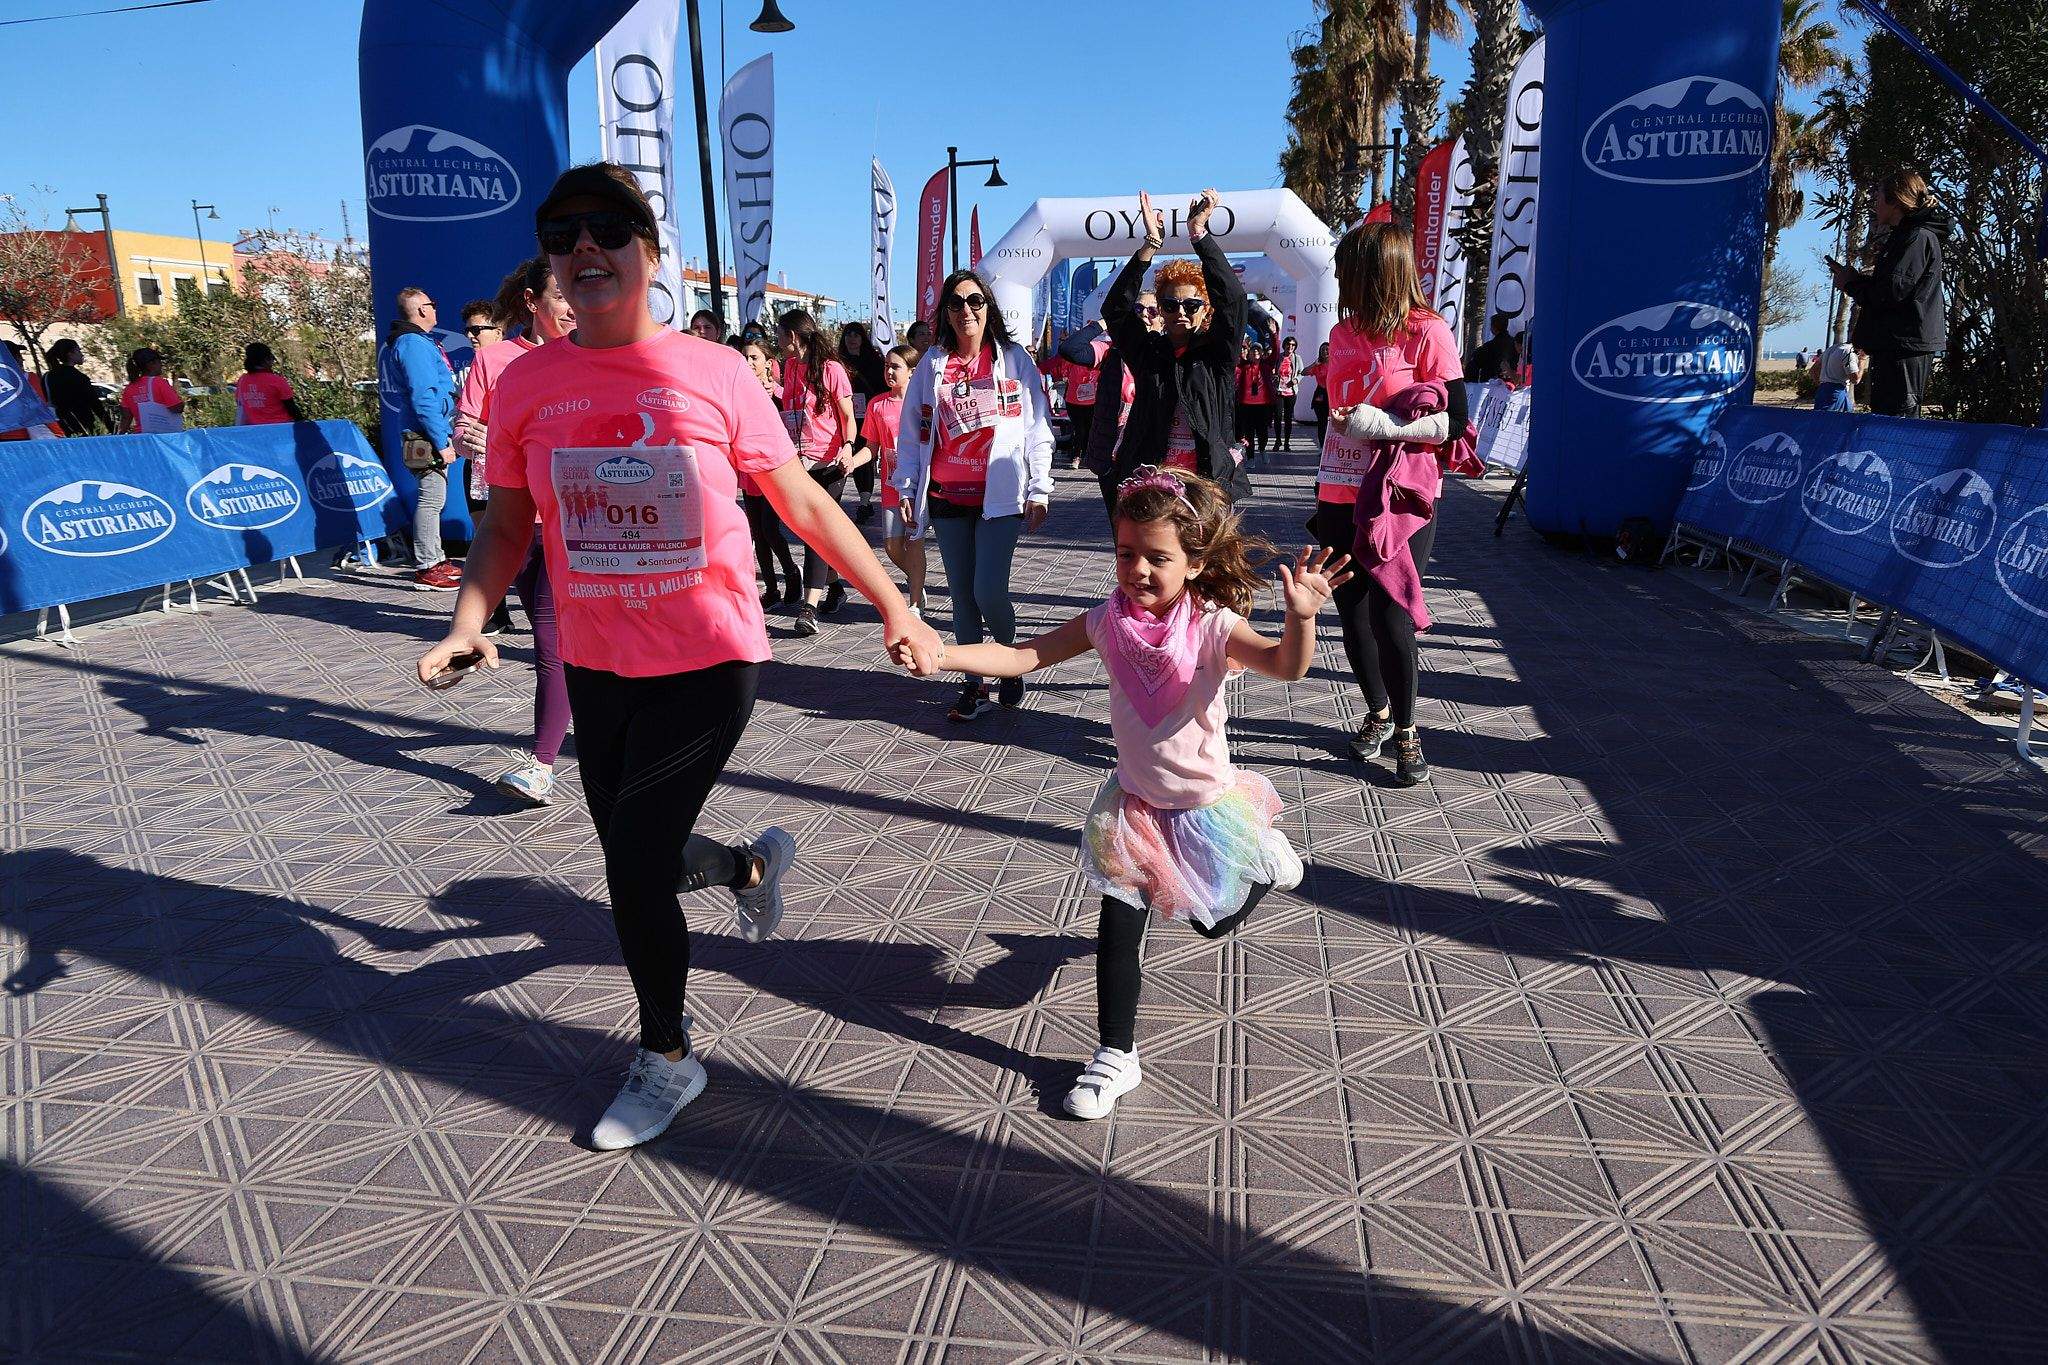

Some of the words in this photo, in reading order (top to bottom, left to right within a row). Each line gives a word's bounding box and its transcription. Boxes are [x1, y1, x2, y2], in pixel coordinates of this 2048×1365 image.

[1631, 114, 1703, 128] CENTRAL
[1708, 111, 1763, 125] LECHERA
[1595, 123, 1764, 165] ASTURIANA
[378, 158, 427, 169] CENTRAL
[435, 160, 500, 173] LECHERA
[368, 164, 508, 202] ASTURIANA
[1495, 81, 1544, 319] OYSHO
[1421, 171, 1442, 270] Santander
[927, 197, 941, 283] Santander
[1280, 237, 1326, 249] OYSHO
[998, 248, 1042, 259] OYSHO
[1304, 302, 1338, 314] OYSH
[1618, 335, 1689, 348] CENTRAL
[1695, 335, 1747, 347] LECHERA
[1584, 341, 1747, 379] ASTURIANA
[538, 398, 591, 420] OYSHO
[640, 394, 687, 409] ASTURIANA
[956, 399, 977, 411] 016
[1338, 448, 1361, 460] 016
[599, 467, 651, 478] ASTURIANA
[215, 486, 249, 496] CENTRAL
[250, 481, 286, 492] LECHERA
[55, 505, 105, 518] CENTRAL
[108, 500, 155, 512] LECHERA
[199, 488, 296, 521] ASTURIANA
[606, 505, 659, 525] 016
[40, 509, 169, 545] ASTURIANA
[621, 530, 641, 540] 494
[580, 542, 607, 550] CARRERA
[580, 556, 620, 567] OYSHO
[648, 556, 690, 566] Santander
[568, 582, 619, 599] CARRERA
[619, 583, 636, 598] DE
[639, 582, 658, 598] LA
[659, 571, 704, 596] MUJER
[624, 599, 649, 611] 2025
